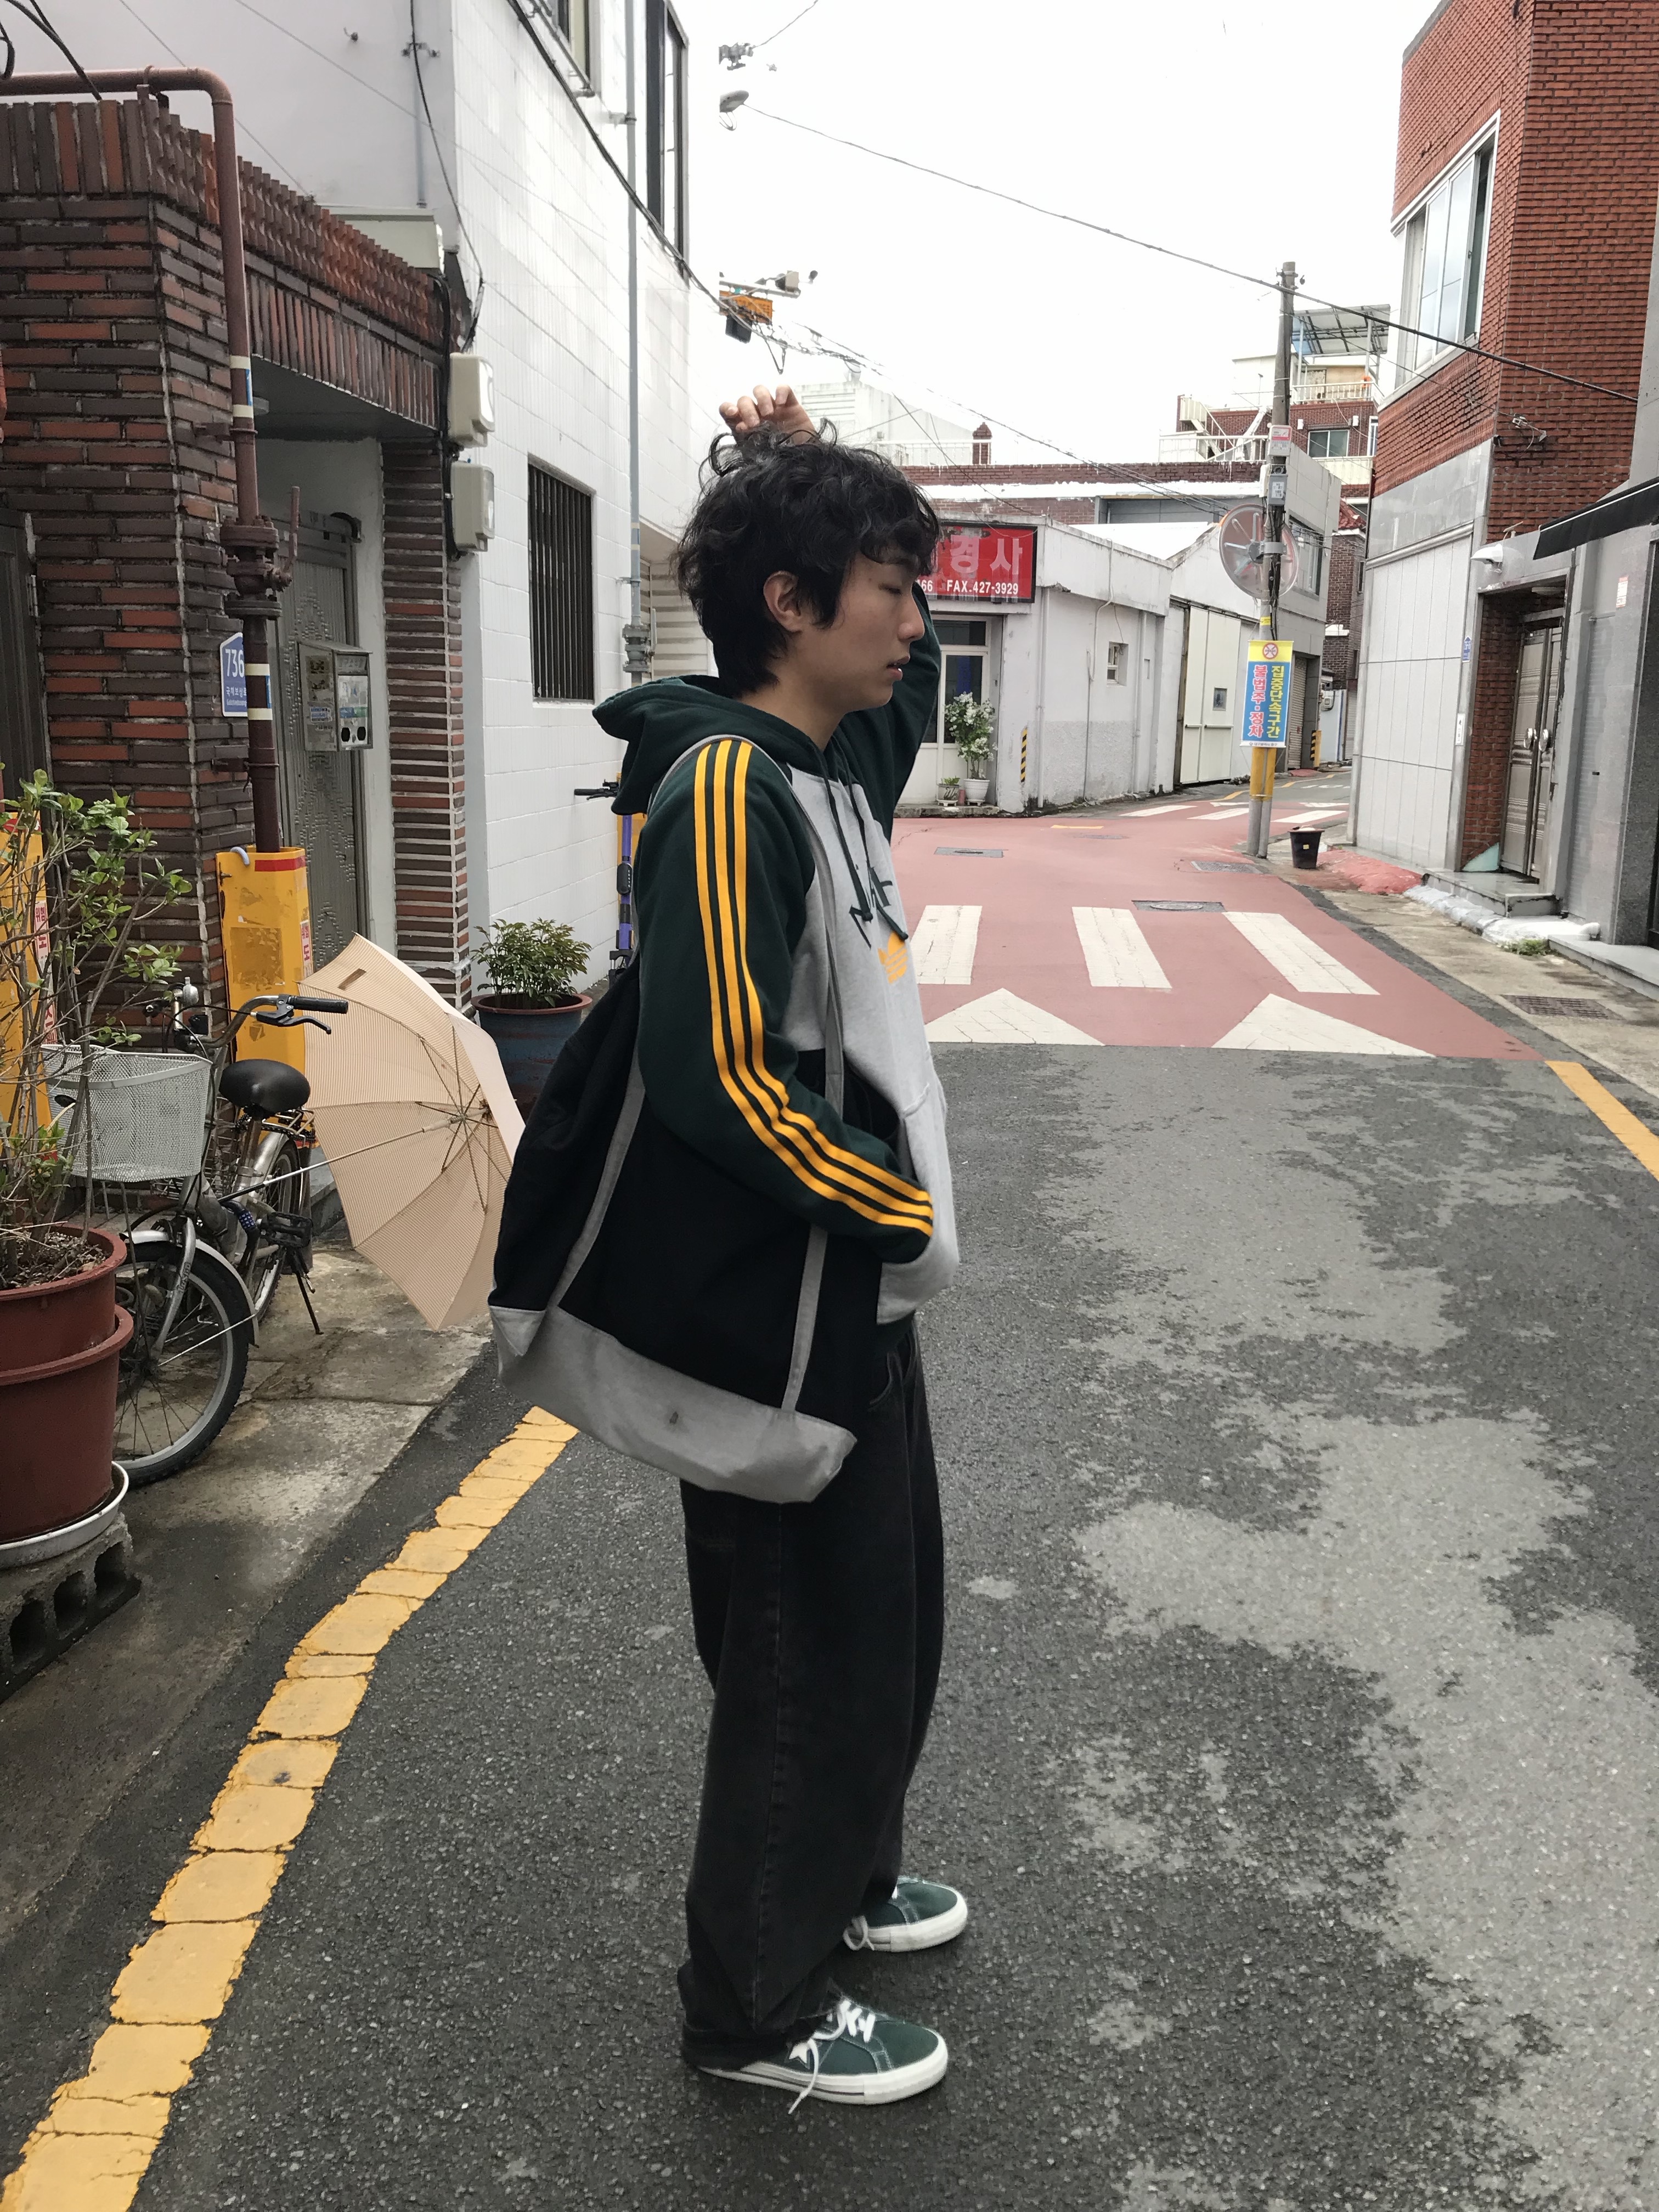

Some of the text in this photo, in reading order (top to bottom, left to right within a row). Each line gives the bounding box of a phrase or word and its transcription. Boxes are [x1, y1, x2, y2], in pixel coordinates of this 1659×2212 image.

[931, 534, 1023, 574] 경사
[946, 579, 1019, 595] FAX.427-3929
[225, 649, 244, 678] 736
[1266, 665, 1284, 738] 집중단속구간
[35, 906, 46, 922] 위험
